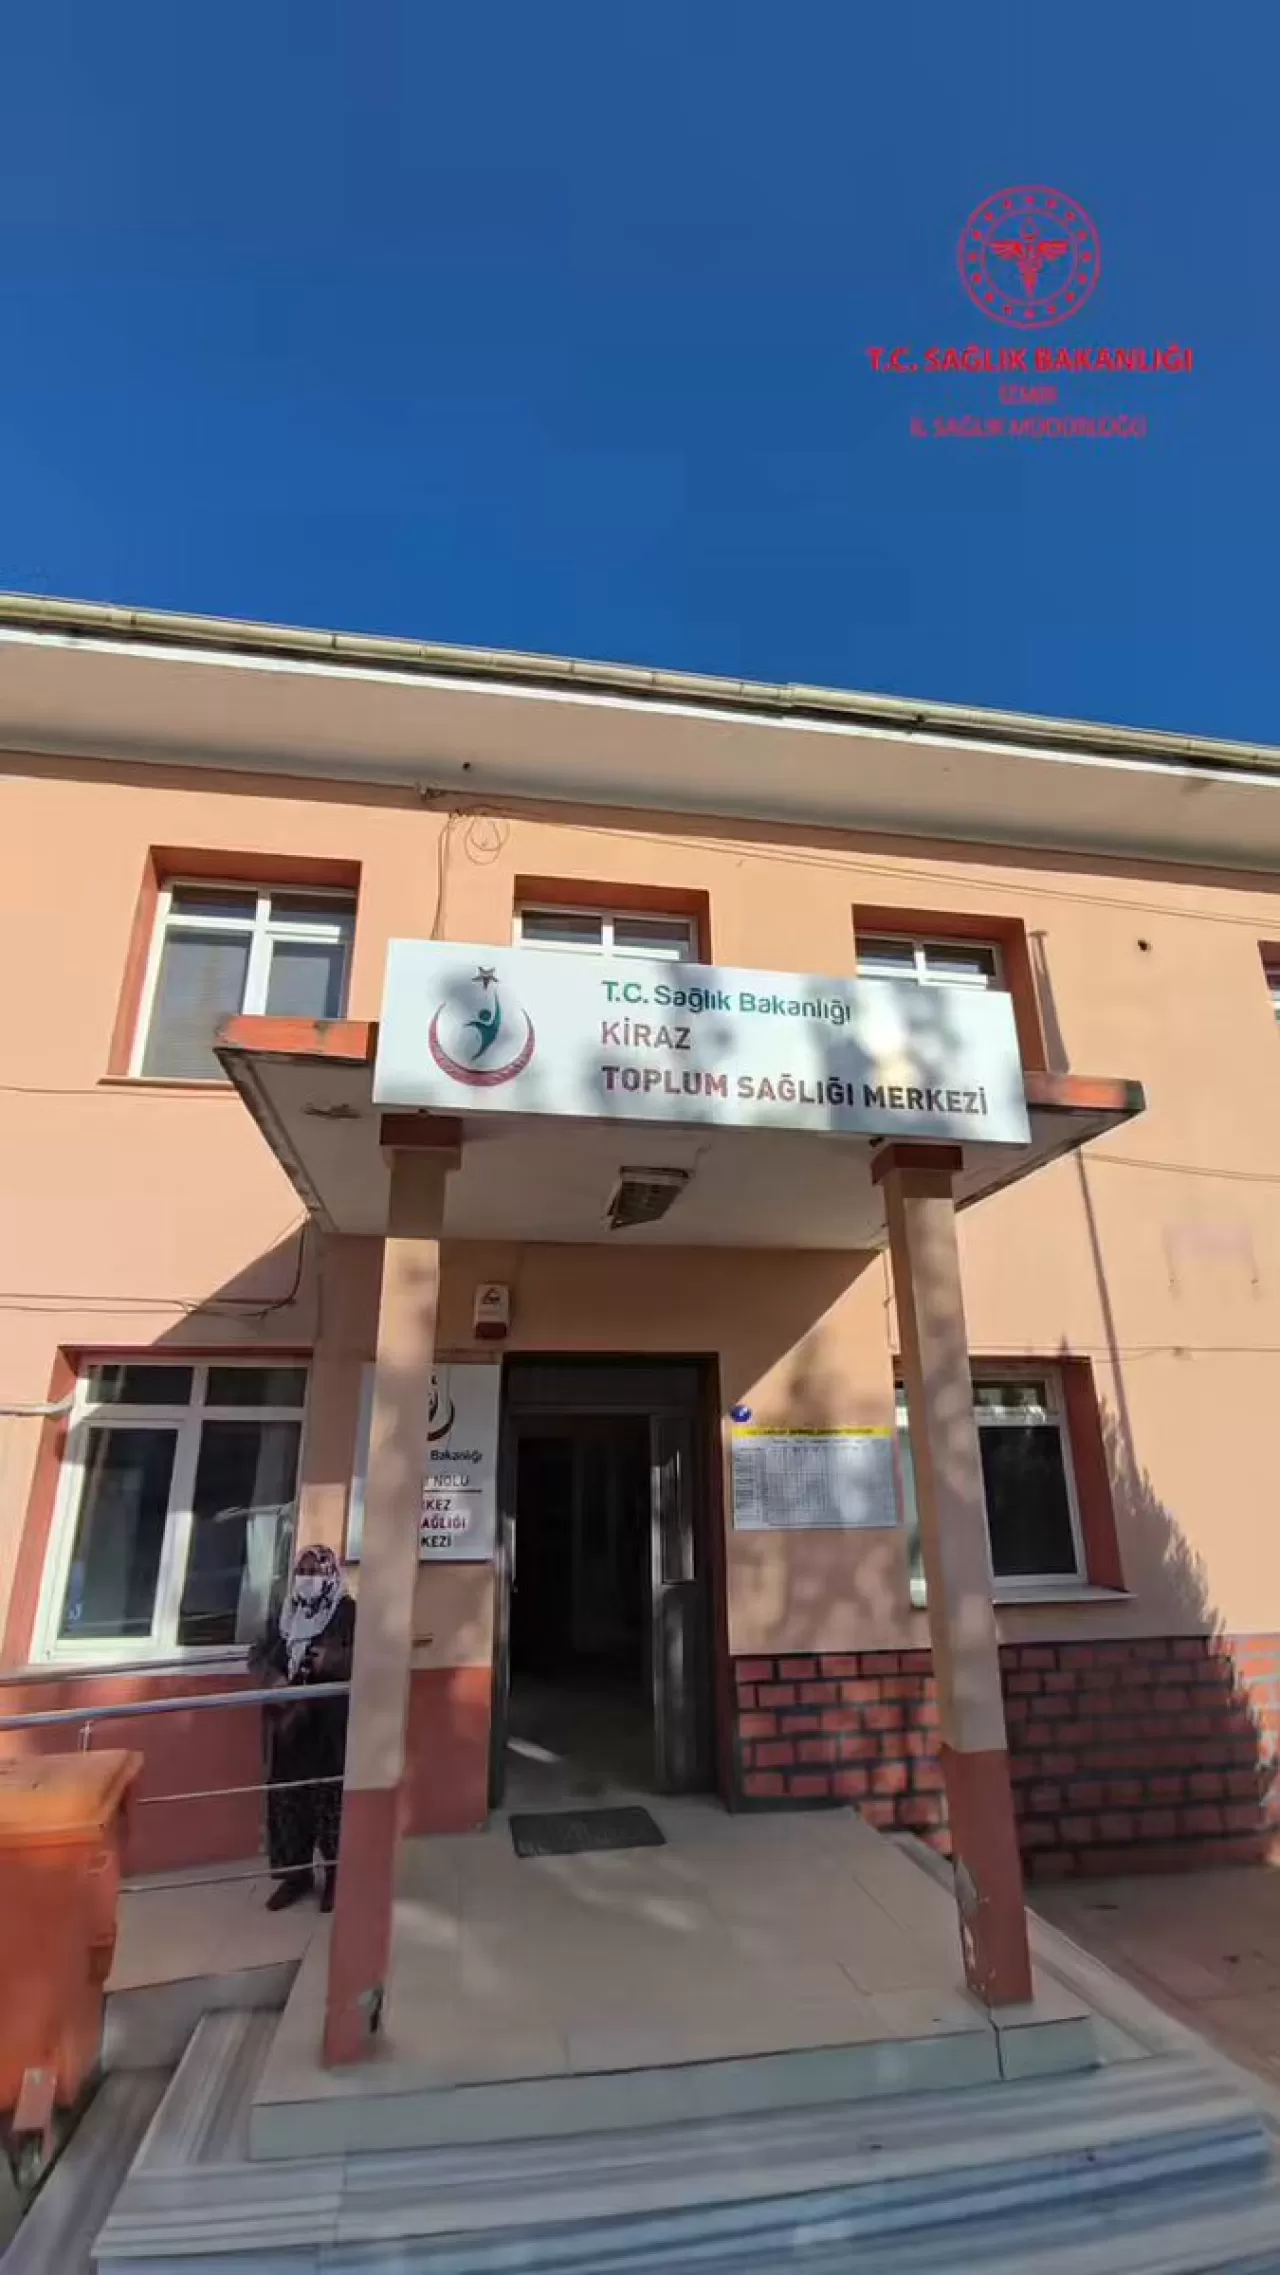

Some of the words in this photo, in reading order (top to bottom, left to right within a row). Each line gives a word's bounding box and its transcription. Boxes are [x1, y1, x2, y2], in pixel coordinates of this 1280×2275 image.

[601, 980, 649, 1004] T.C.
[654, 985, 731, 1012] Sağlık
[740, 993, 851, 1024] Bakanlığı
[601, 1018, 691, 1050] KİRAZ
[601, 1066, 728, 1098] TOPLUM
[737, 1074, 853, 1106] SAĞLIĞI
[863, 1083, 988, 1116] MERKEZİ
[434, 1475, 469, 1487] NOLU
[423, 1500, 451, 1511] KEZ
[422, 1516, 465, 1529] AĞLIĞI
[421, 1534, 451, 1547] KEZİ
